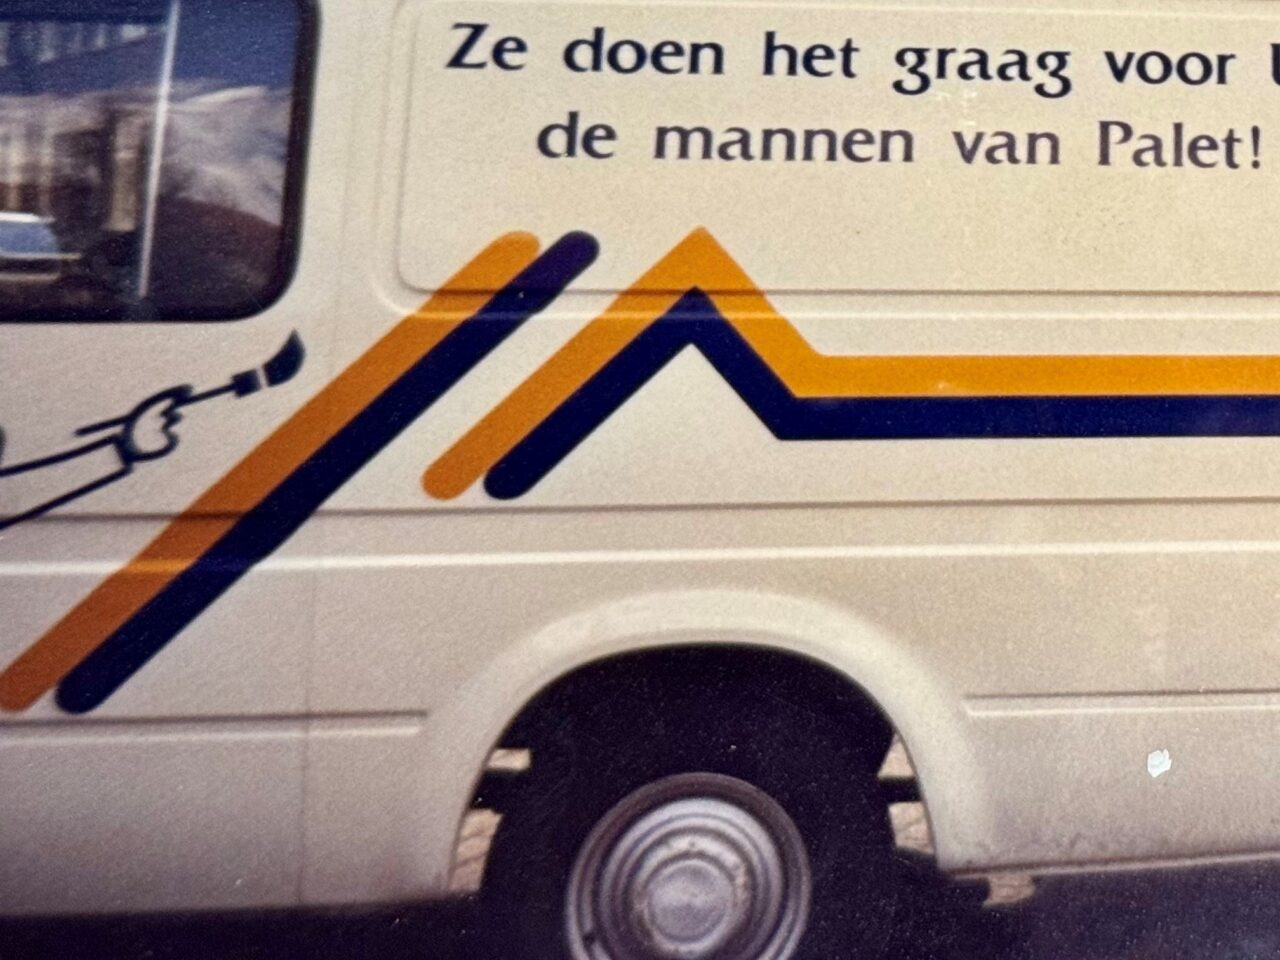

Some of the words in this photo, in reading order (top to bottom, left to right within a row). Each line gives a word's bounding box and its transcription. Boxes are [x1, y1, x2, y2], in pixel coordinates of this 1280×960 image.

[446, 22, 527, 71] Ze
[563, 26, 724, 75] doen
[763, 31, 859, 79] het
[892, 47, 1072, 99] graag
[1104, 50, 1236, 86] voor
[537, 111, 617, 159] de
[654, 126, 913, 163] mannen
[953, 131, 1063, 165] van
[1098, 120, 1265, 170] Palet!
